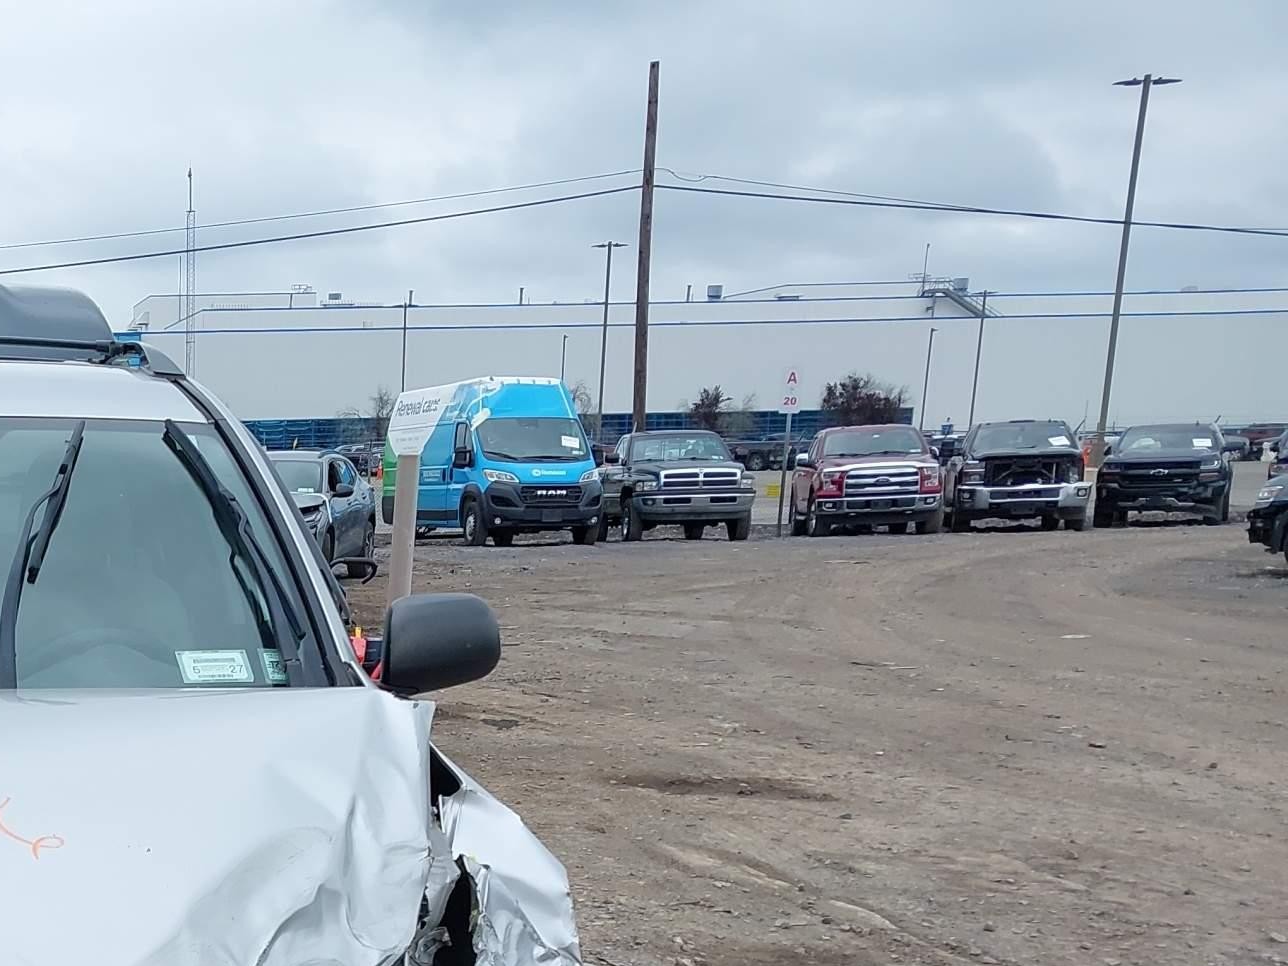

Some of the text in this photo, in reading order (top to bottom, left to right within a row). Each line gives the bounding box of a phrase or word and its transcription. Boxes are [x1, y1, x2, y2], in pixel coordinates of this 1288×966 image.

[787, 371, 797, 384] A
[783, 396, 797, 406] 20
[192, 664, 244, 674] 5 27
